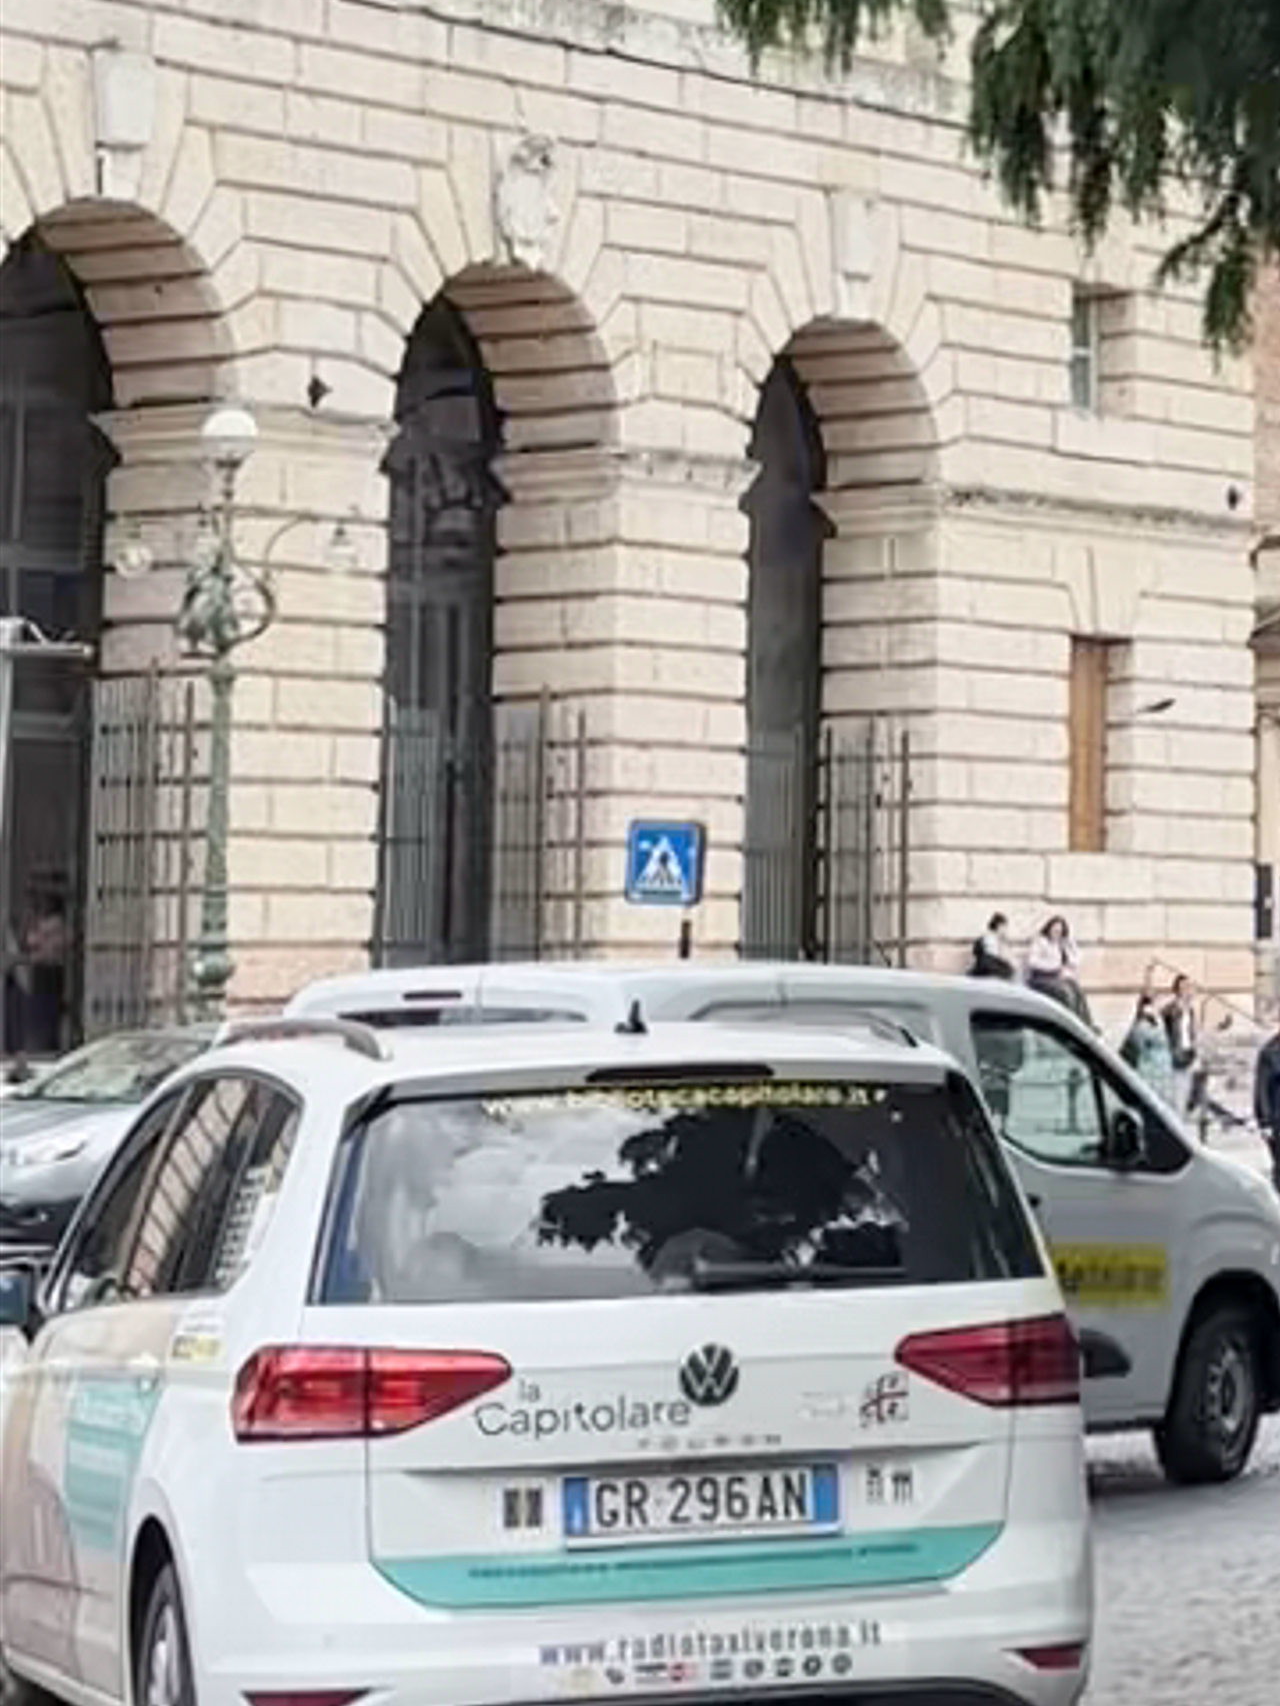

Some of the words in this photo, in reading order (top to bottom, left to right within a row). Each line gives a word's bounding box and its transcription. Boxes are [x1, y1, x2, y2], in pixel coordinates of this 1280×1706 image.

[518, 1379, 541, 1403] la
[475, 1394, 690, 1441] Capitolare
[595, 1479, 650, 1528] GR
[540, 1620, 882, 1665] www.radiotaxiverona.it
